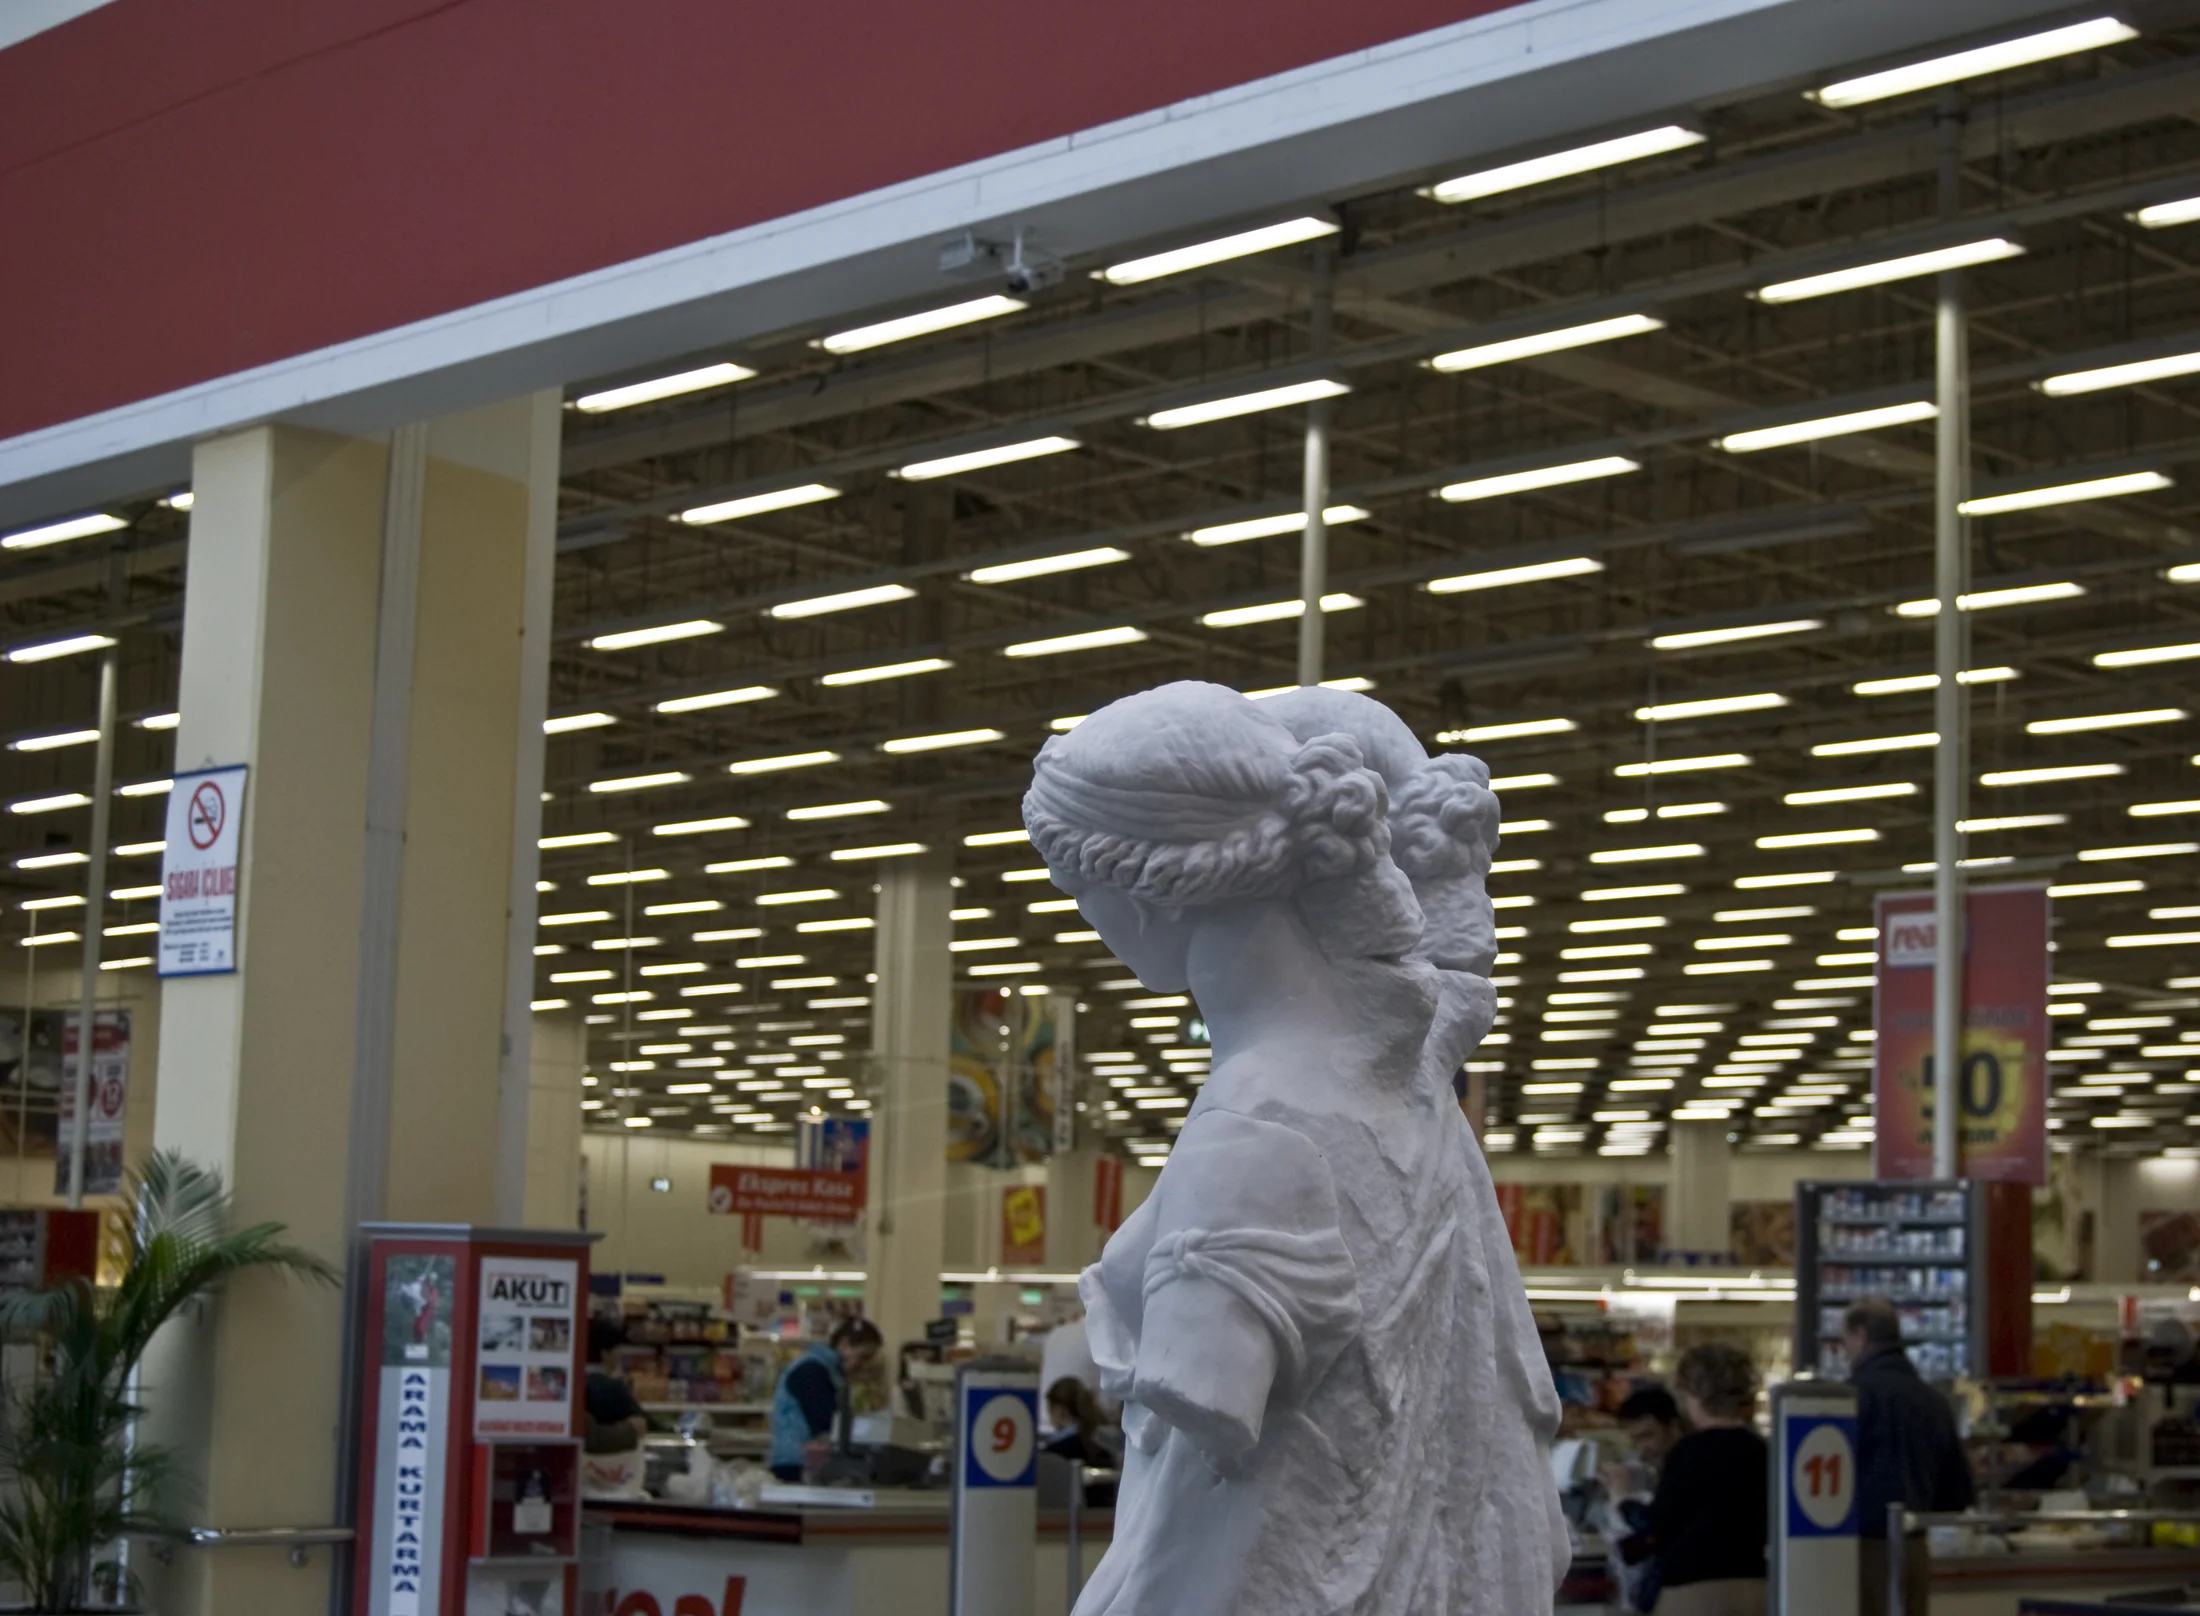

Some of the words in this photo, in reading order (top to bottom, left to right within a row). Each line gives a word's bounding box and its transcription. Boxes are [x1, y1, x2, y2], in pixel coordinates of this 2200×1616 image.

[1892, 923, 1936, 952] rea
[493, 1278, 564, 1302] AKUT
[399, 1374, 426, 1449] ARAMA
[991, 1416, 1017, 1454] 9
[1802, 1453, 1842, 1498] 11
[392, 1466, 422, 1593] KURTARMA
